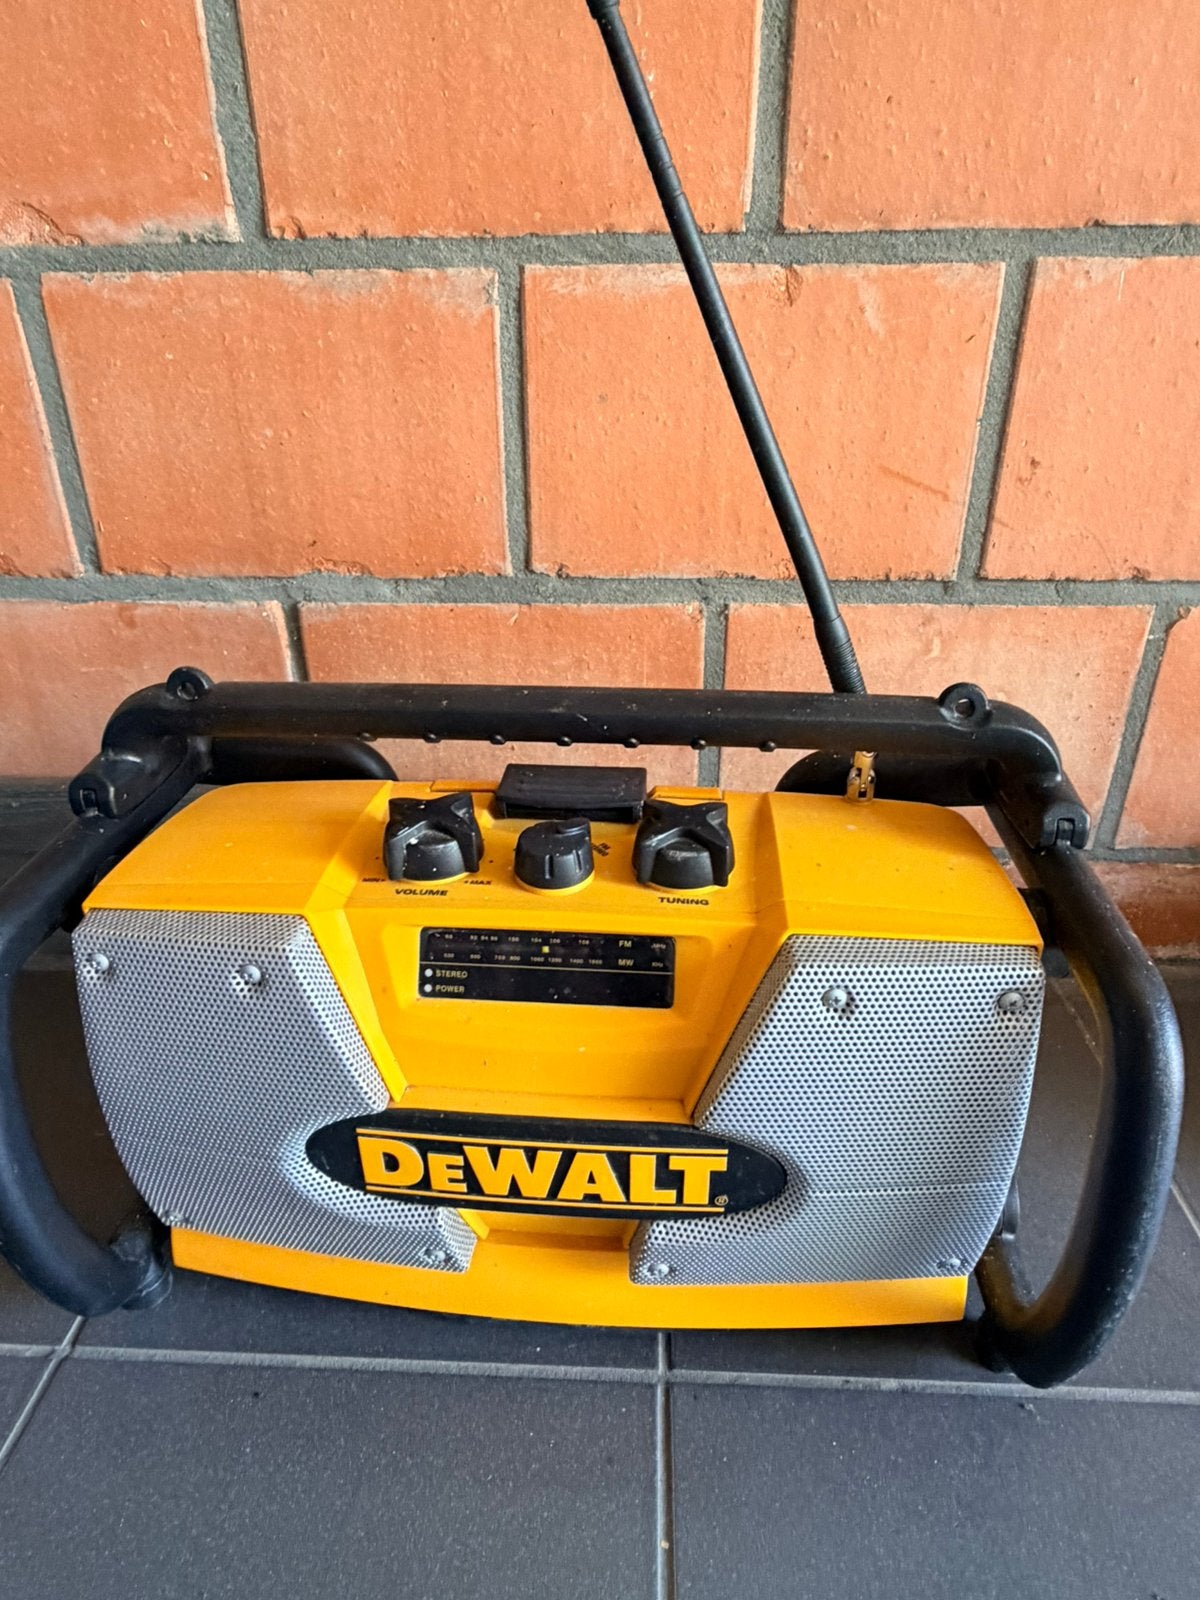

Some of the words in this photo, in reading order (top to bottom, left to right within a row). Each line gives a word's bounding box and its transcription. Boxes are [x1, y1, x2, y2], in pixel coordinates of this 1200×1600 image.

[395, 888, 448, 896] VOLUME
[658, 896, 709, 906] TUNING
[618, 940, 632, 948] FM
[618, 958, 634, 967] MW
[435, 969, 468, 979] STEREO
[435, 985, 465, 994] POWER
